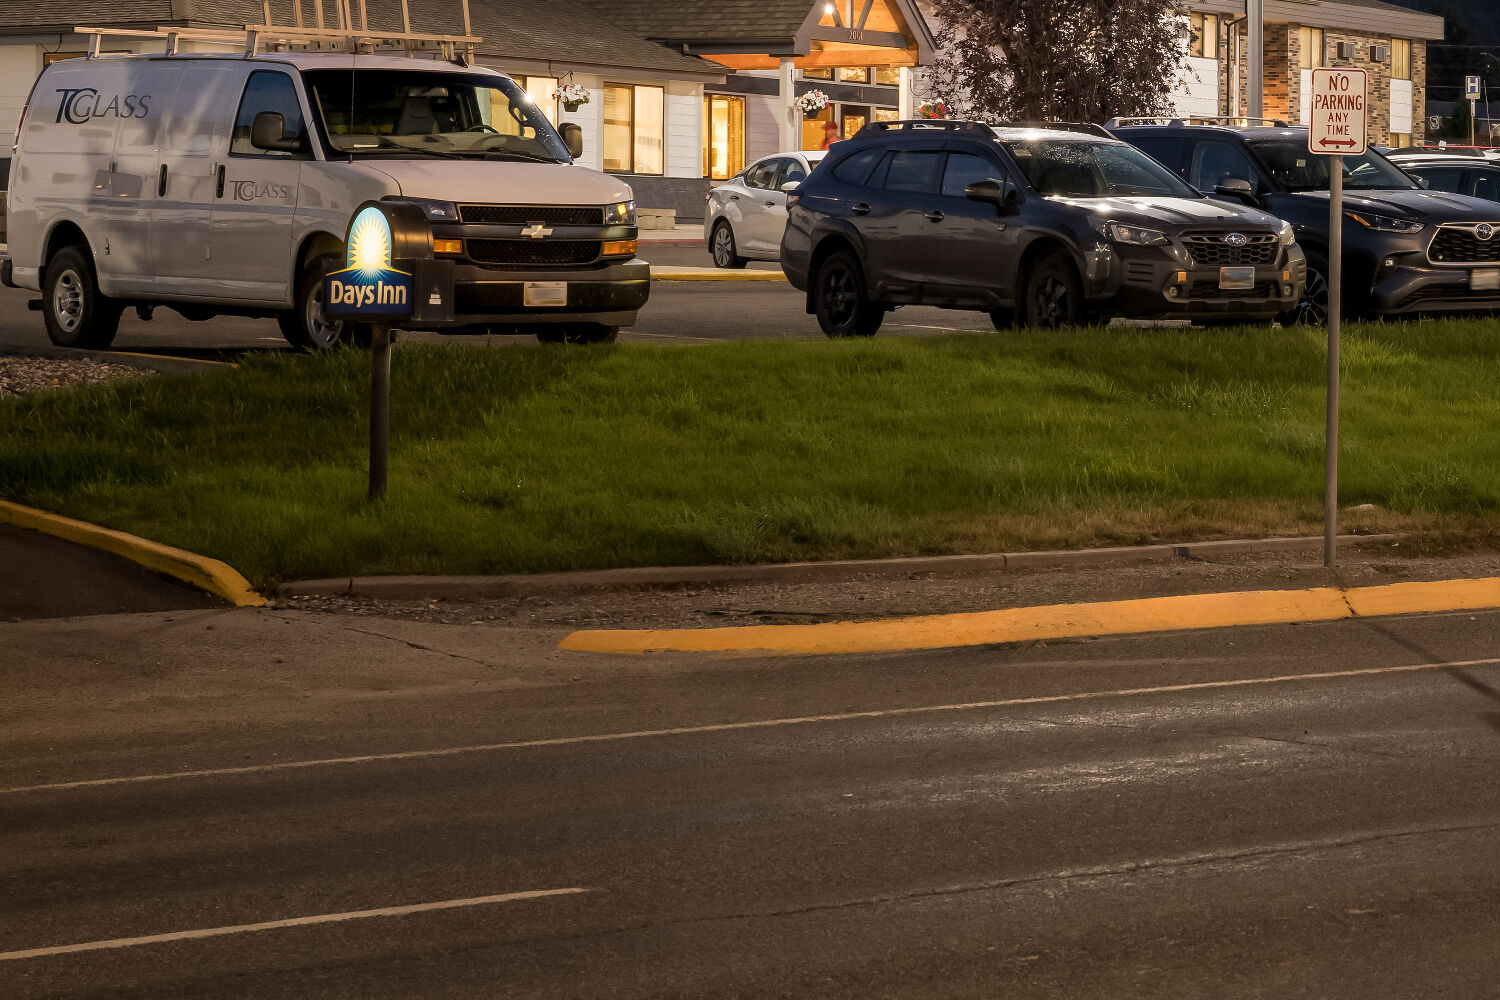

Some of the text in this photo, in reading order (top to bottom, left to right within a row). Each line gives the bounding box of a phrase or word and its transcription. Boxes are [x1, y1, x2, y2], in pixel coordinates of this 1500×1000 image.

[1329, 75, 1349, 92] NO
[1467, 77, 1479, 93] H
[1315, 94, 1363, 111] PARKING
[1328, 112, 1349, 123] ANY
[1327, 124, 1350, 136] TIME
[330, 280, 407, 308] Days Inn
